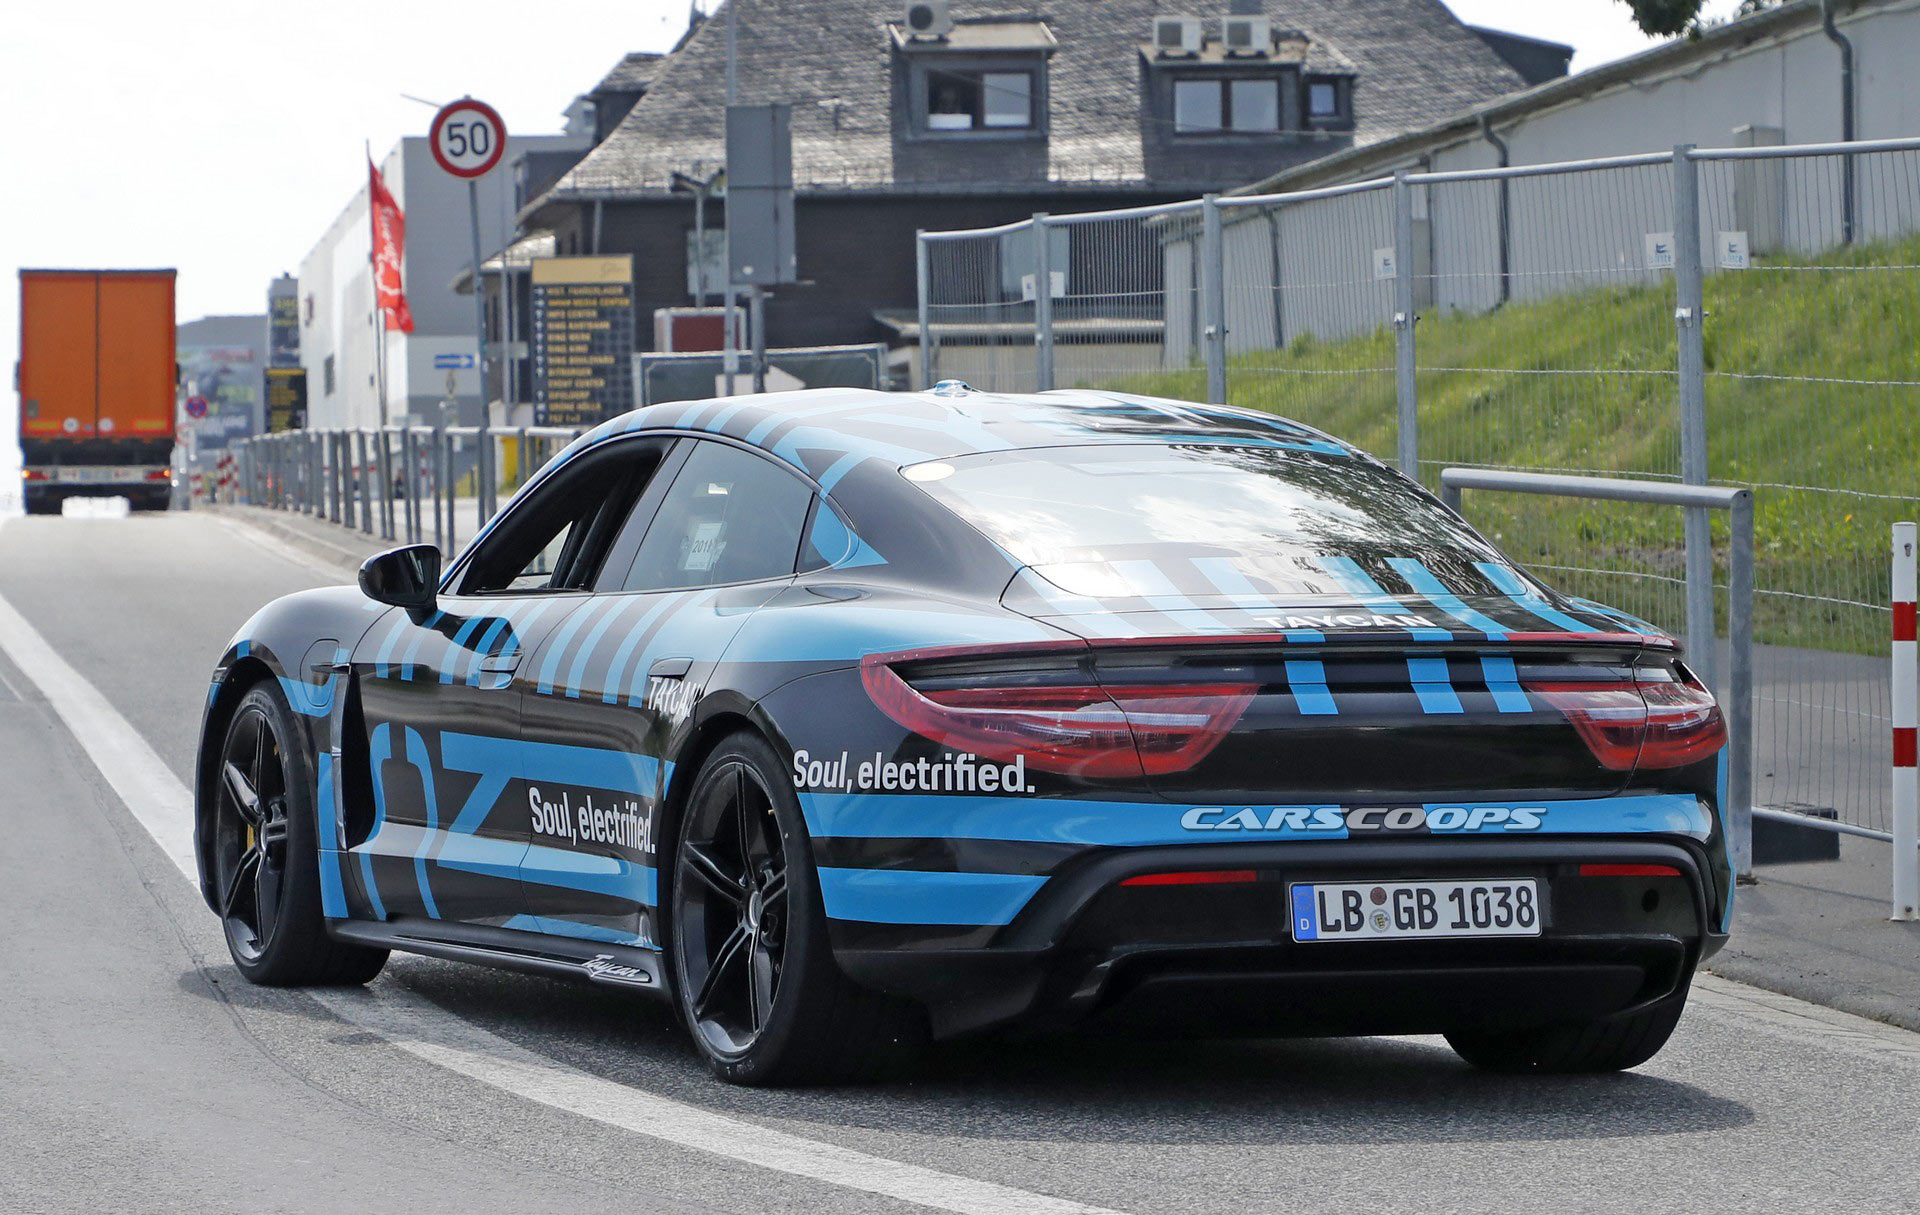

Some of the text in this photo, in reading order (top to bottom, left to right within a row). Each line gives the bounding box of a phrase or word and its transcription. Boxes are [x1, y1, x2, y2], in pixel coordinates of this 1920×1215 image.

[447, 121, 489, 157] 50
[1253, 615, 1438, 628] TAYCAN
[793, 750, 1036, 794] Soul, electrified.
[528, 786, 656, 854] Soul, electrified.
[1300, 885, 1536, 933] D LB GB 1038
[581, 953, 641, 978] Taycan
